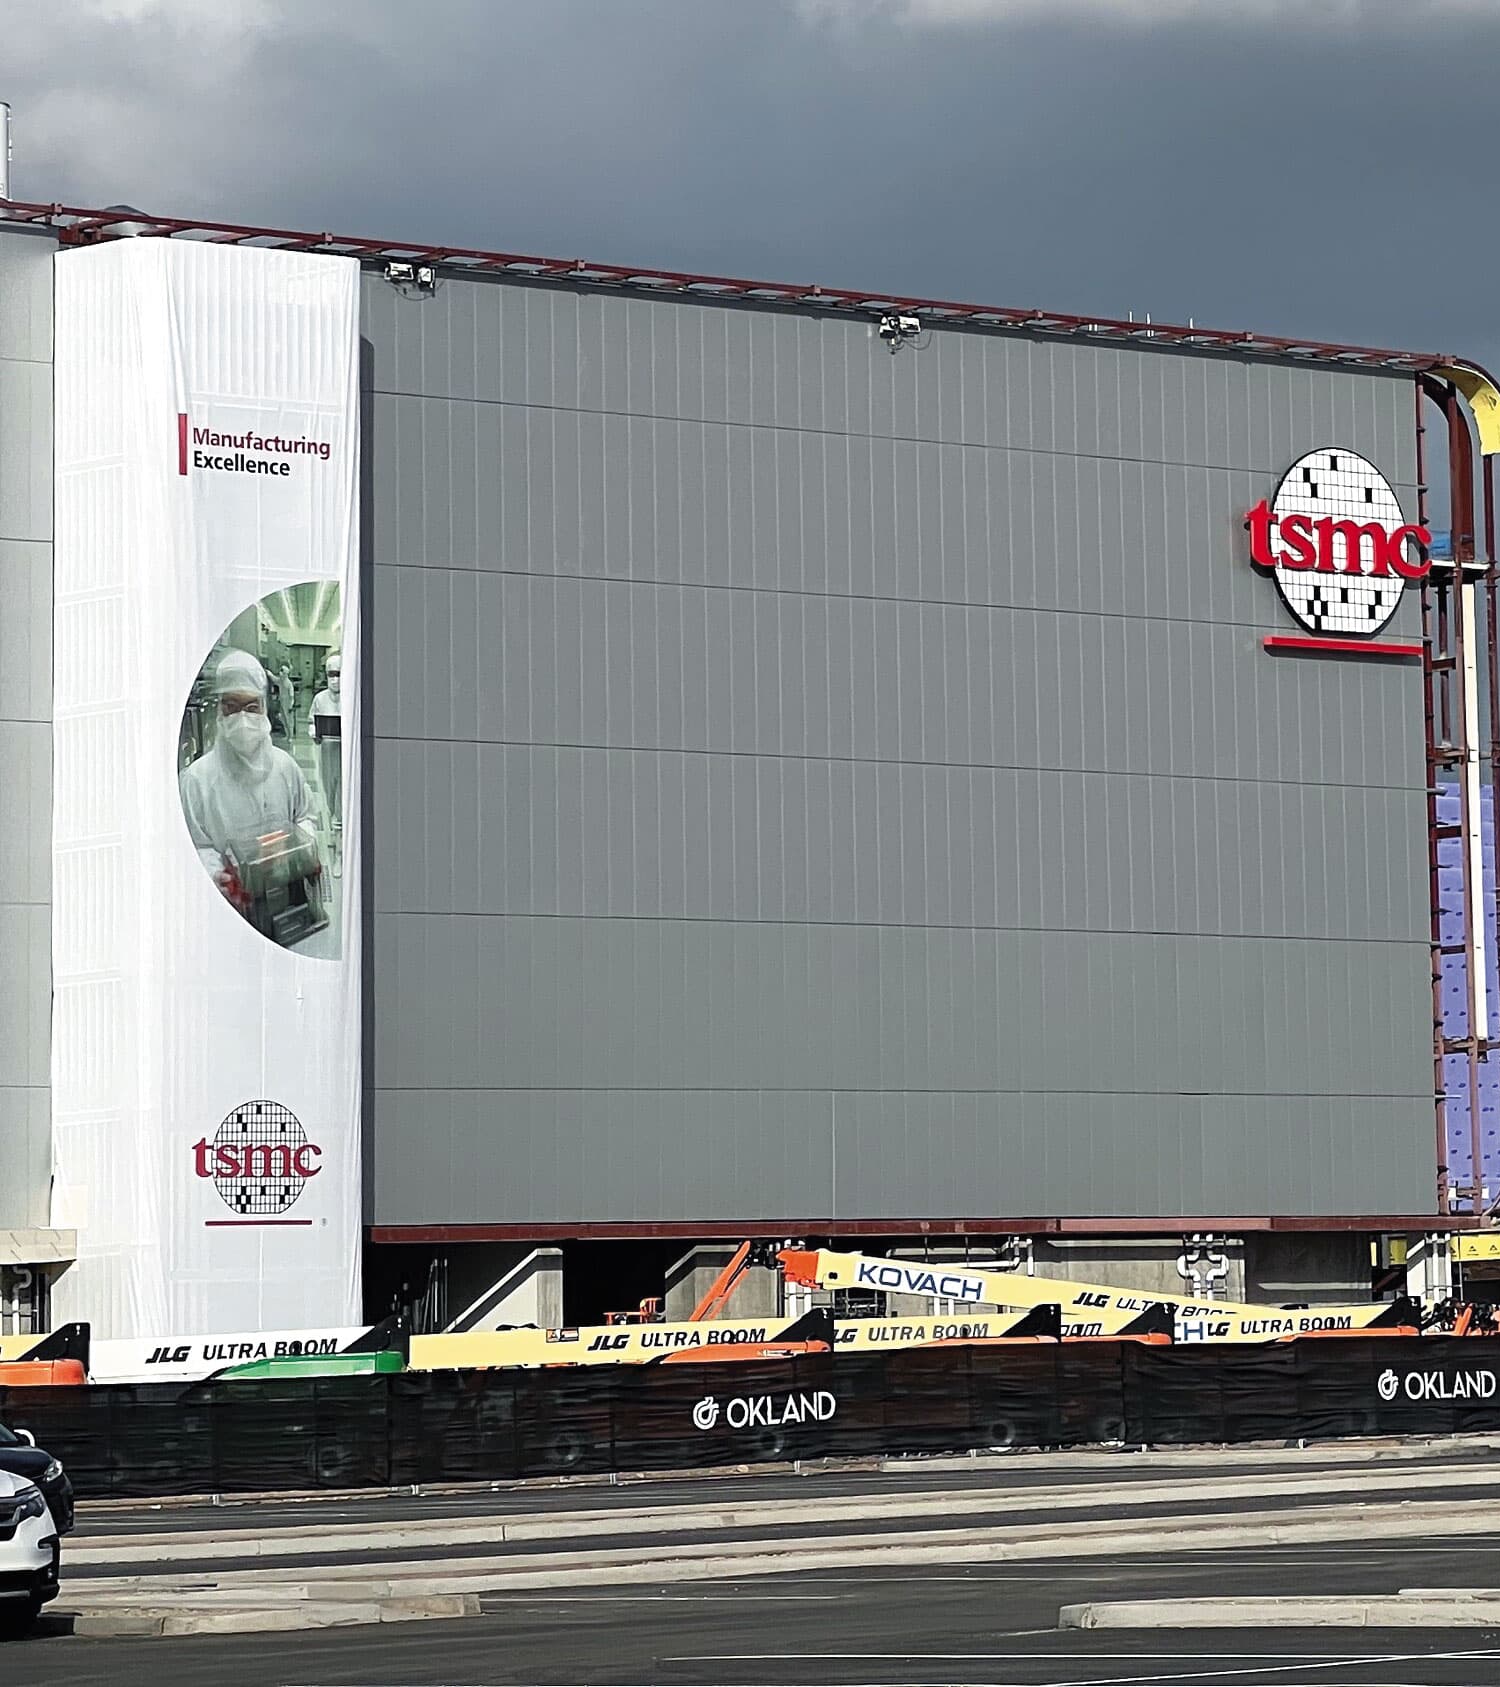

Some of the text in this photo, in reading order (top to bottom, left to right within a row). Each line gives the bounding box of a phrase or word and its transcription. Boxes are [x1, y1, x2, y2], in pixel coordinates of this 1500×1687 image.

[193, 427, 331, 460] Manufacturing
[193, 450, 291, 476] Excellence
[1244, 499, 1432, 578] tsmc
[191, 1137, 322, 1178] tsmc
[858, 1263, 982, 1300] KOVACH
[1072, 1292, 1110, 1308] JLG
[868, 1326, 926, 1341] ULTRA
[933, 1323, 989, 1339] BOOM
[1240, 1318, 1294, 1334] ULTRA
[1300, 1316, 1352, 1331] BOOM
[145, 1338, 338, 1364] JLG ULTRA BOOM
[587, 1328, 766, 1351] JLG ULTRA BOOM
[1404, 1370, 1497, 1400] OKLAND
[726, 1391, 837, 1428] OKLAND
